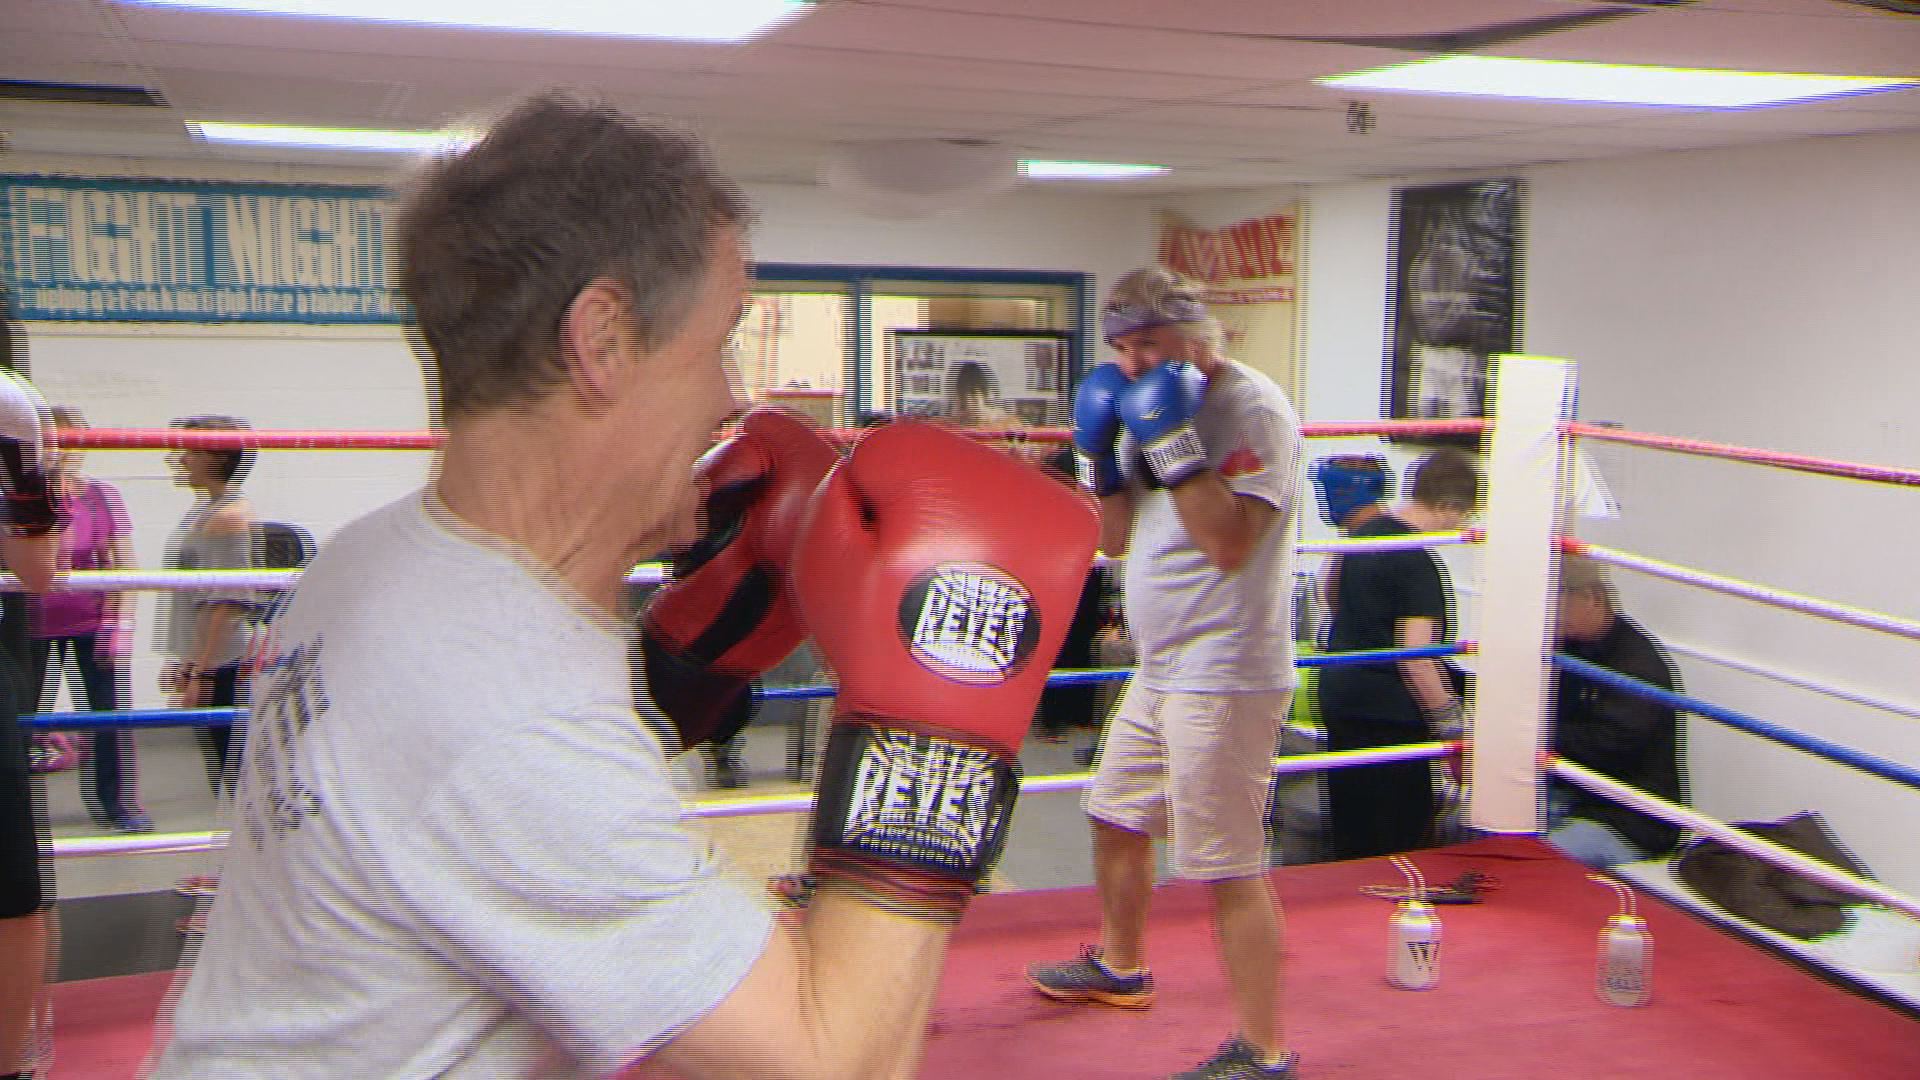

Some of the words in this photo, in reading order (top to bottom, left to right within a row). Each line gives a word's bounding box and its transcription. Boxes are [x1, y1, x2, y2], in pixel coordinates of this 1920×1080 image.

[11, 186, 209, 286] FIGHT
[211, 194, 398, 289] NIGHT
[911, 578, 1026, 665] REYES
[843, 746, 994, 845] REYES
